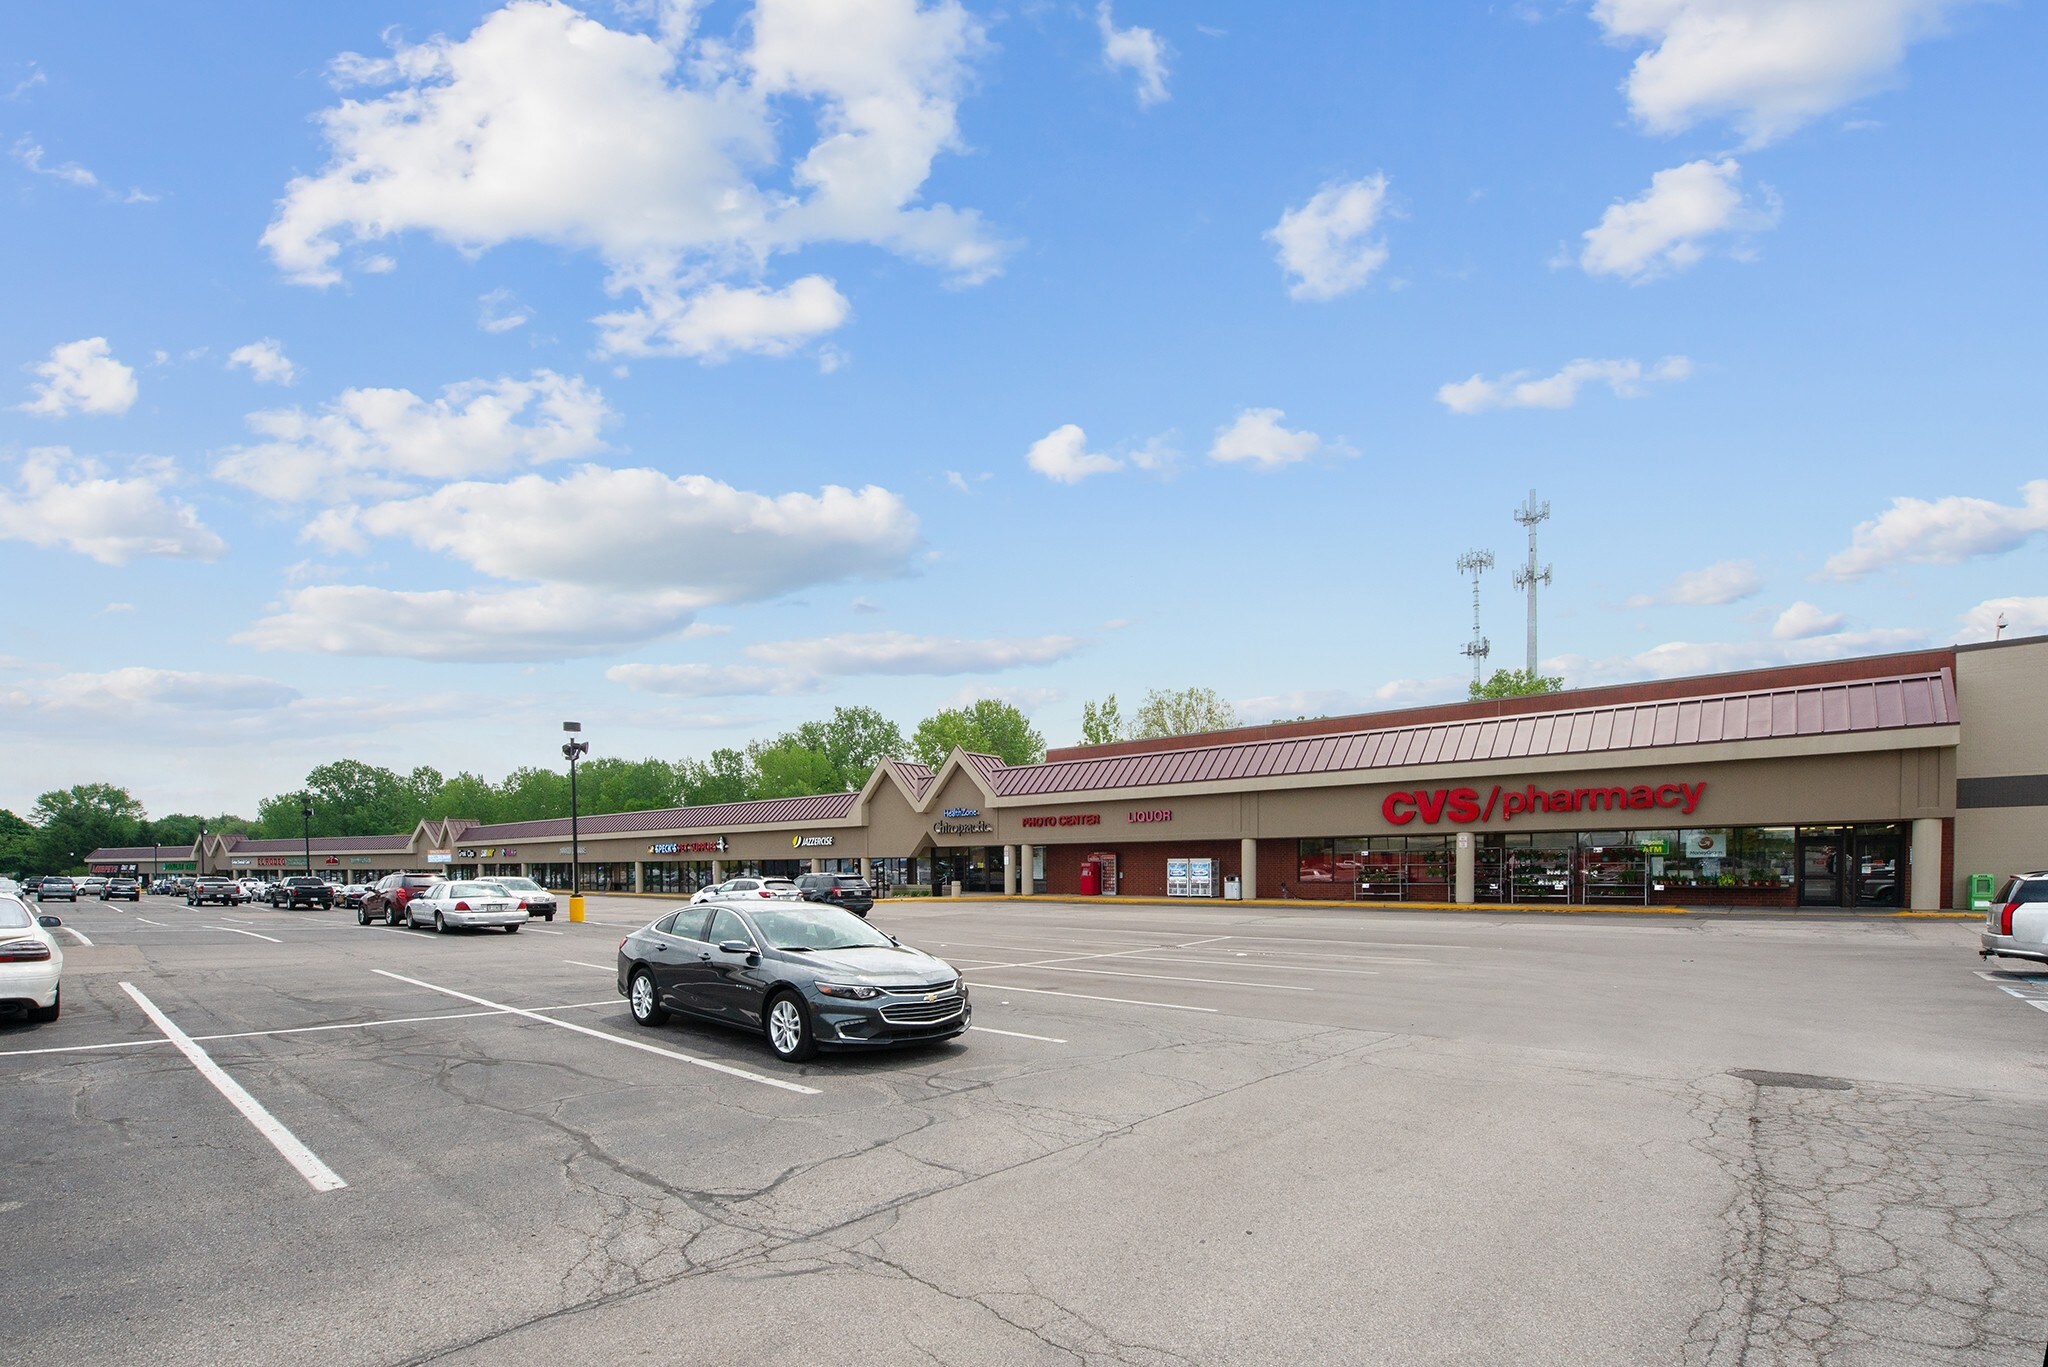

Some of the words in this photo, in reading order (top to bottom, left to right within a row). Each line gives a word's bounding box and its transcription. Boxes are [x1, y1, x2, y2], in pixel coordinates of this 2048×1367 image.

[1381, 781, 1706, 825] CVS/pharmacy
[1022, 816, 1057, 828] PHOTO
[1058, 814, 1100, 827] CENTER
[1127, 809, 1172, 823] LIQUOR
[933, 820, 993, 837] Chiropractic
[691, 841, 718, 853] SUPPLIES
[801, 836, 834, 847] JAZZERCISE
